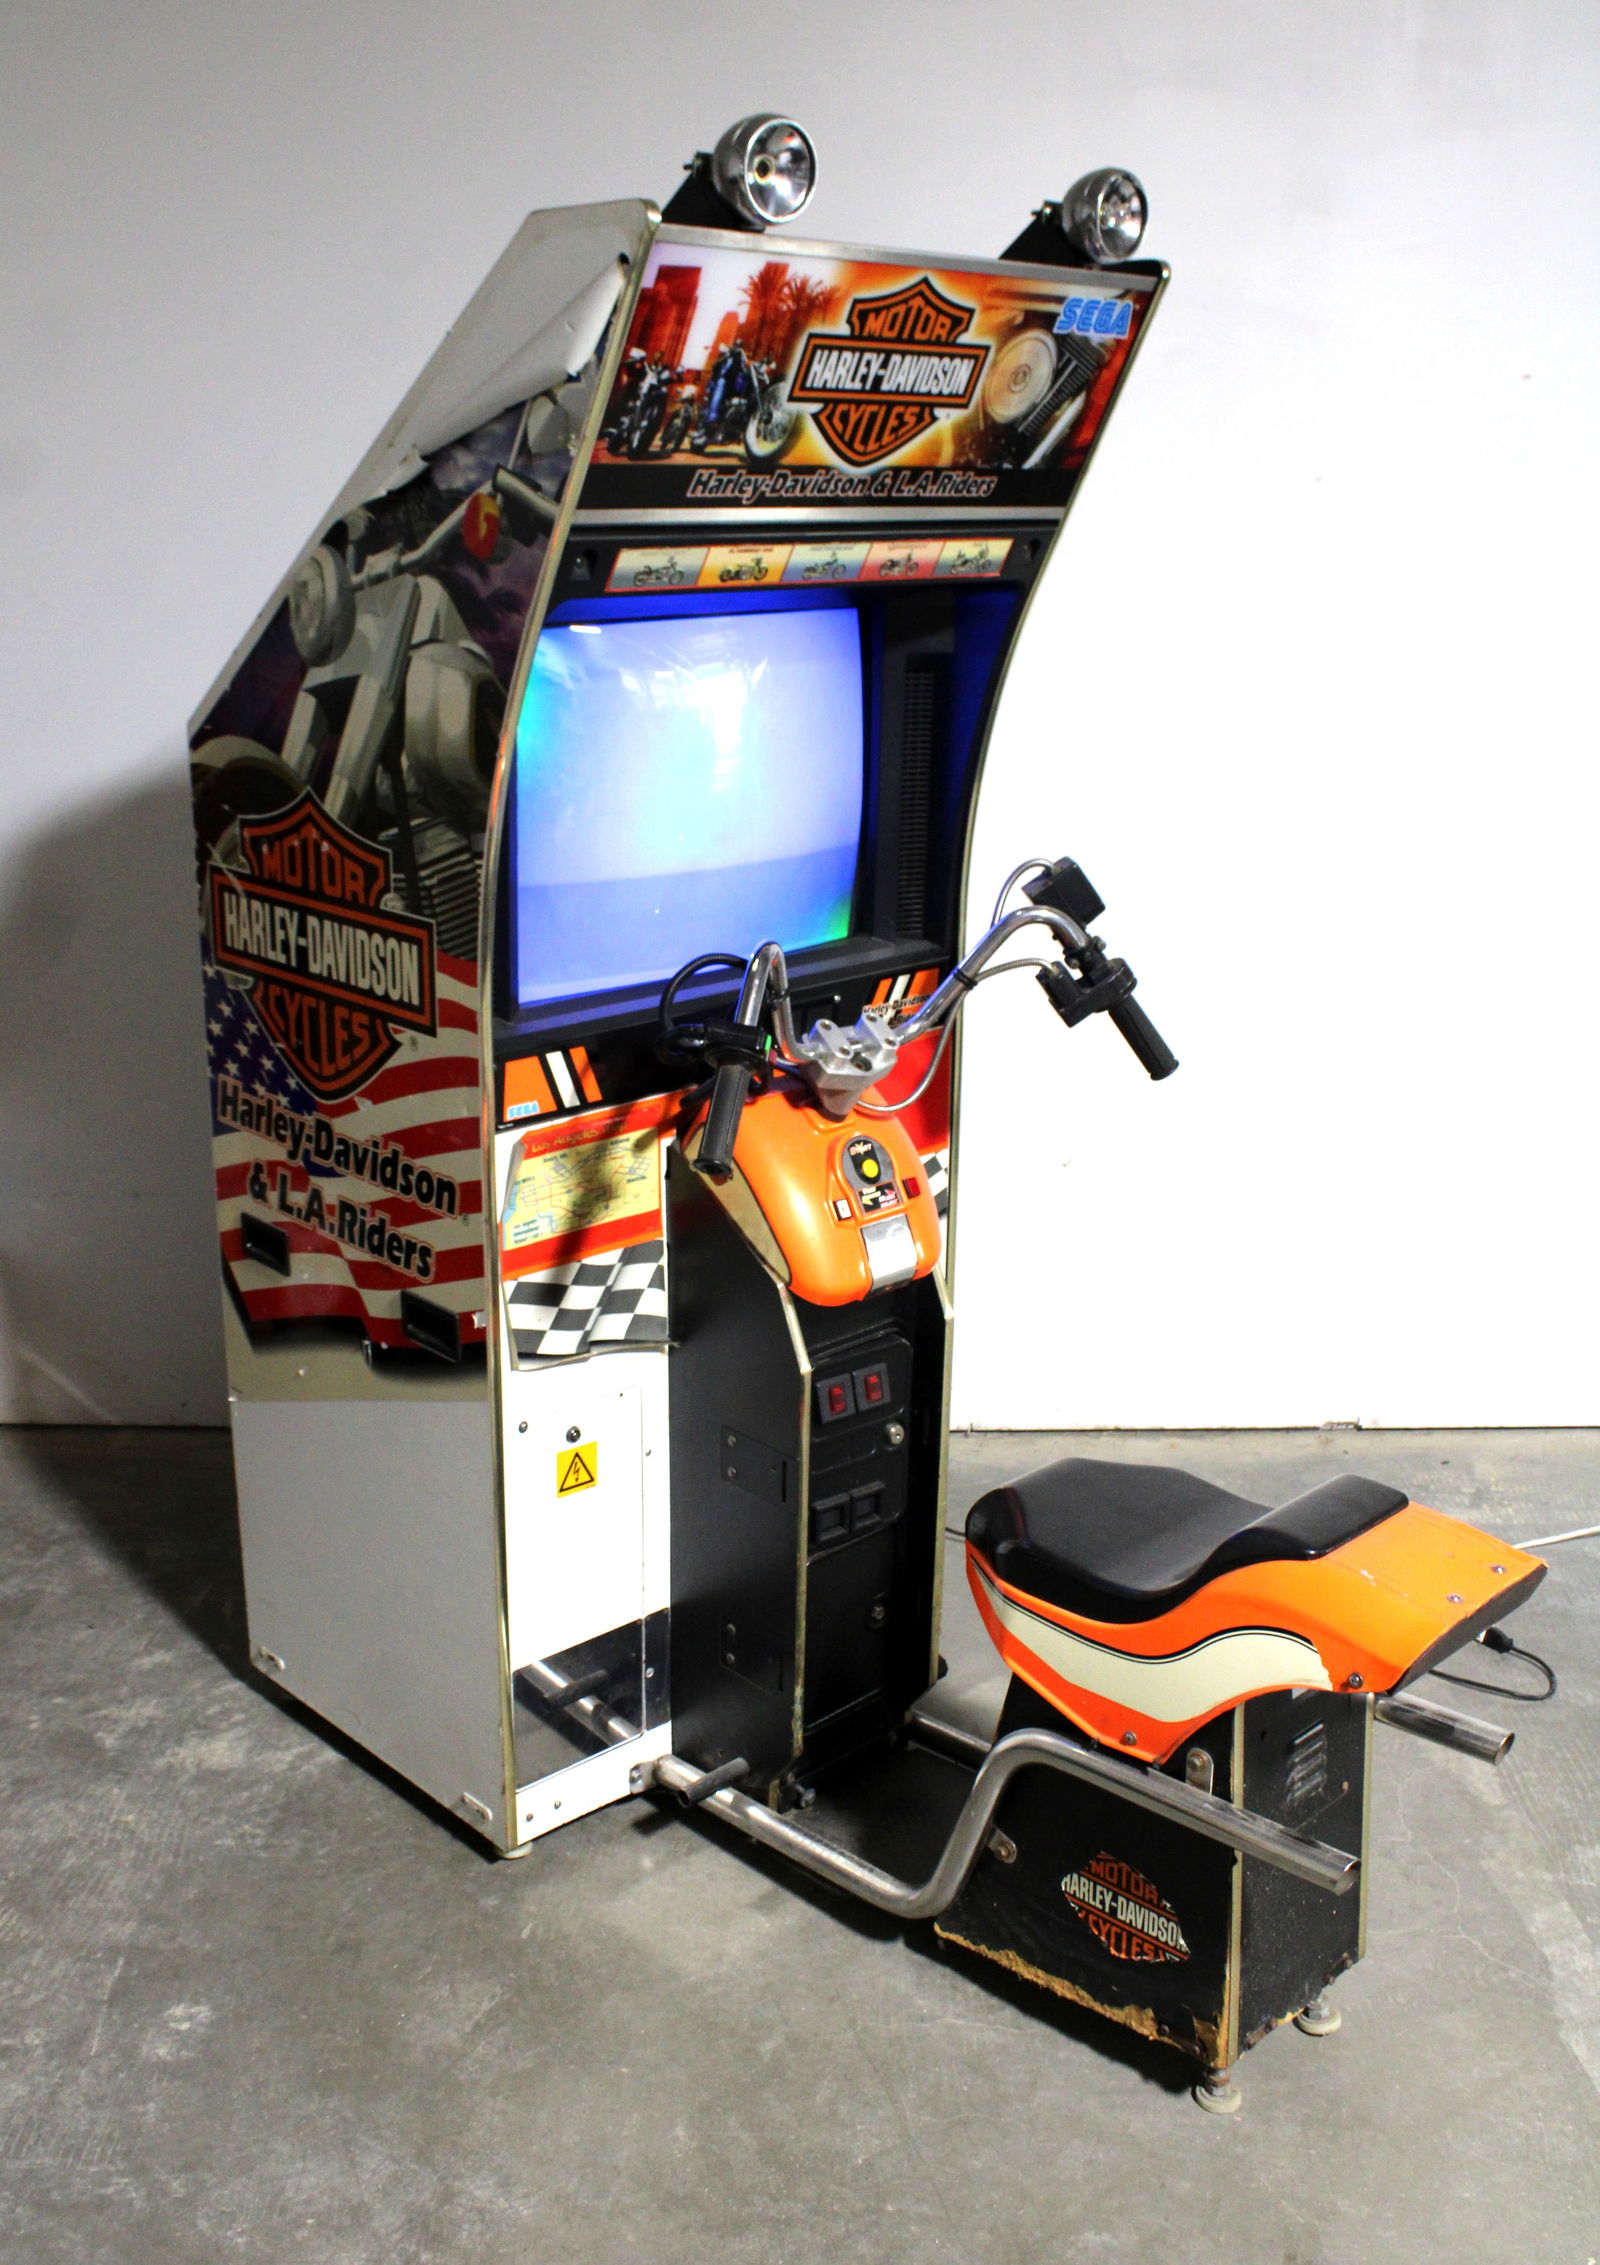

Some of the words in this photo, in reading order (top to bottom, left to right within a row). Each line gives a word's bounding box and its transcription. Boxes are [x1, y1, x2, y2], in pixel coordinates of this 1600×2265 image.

[863, 295, 952, 342] MOTOR
[1054, 297, 1133, 338] SEGA
[805, 349, 975, 396] HARLEY-DAVIDSON
[832, 403, 921, 453] CYCLES
[687, 469, 869, 505] Harley-Davidson
[871, 471, 892, 498] &
[262, 825, 365, 902] MOTOR
[222, 891, 420, 1006] HARLEY-DAVIDSON
[268, 986, 372, 1077] CYCLES
[217, 1074, 460, 1218] Harley-Davidson
[246, 1159, 270, 1203] &
[1091, 1859, 1159, 1904] MOTOR
[1088, 1913, 1156, 1961] CYCLES
